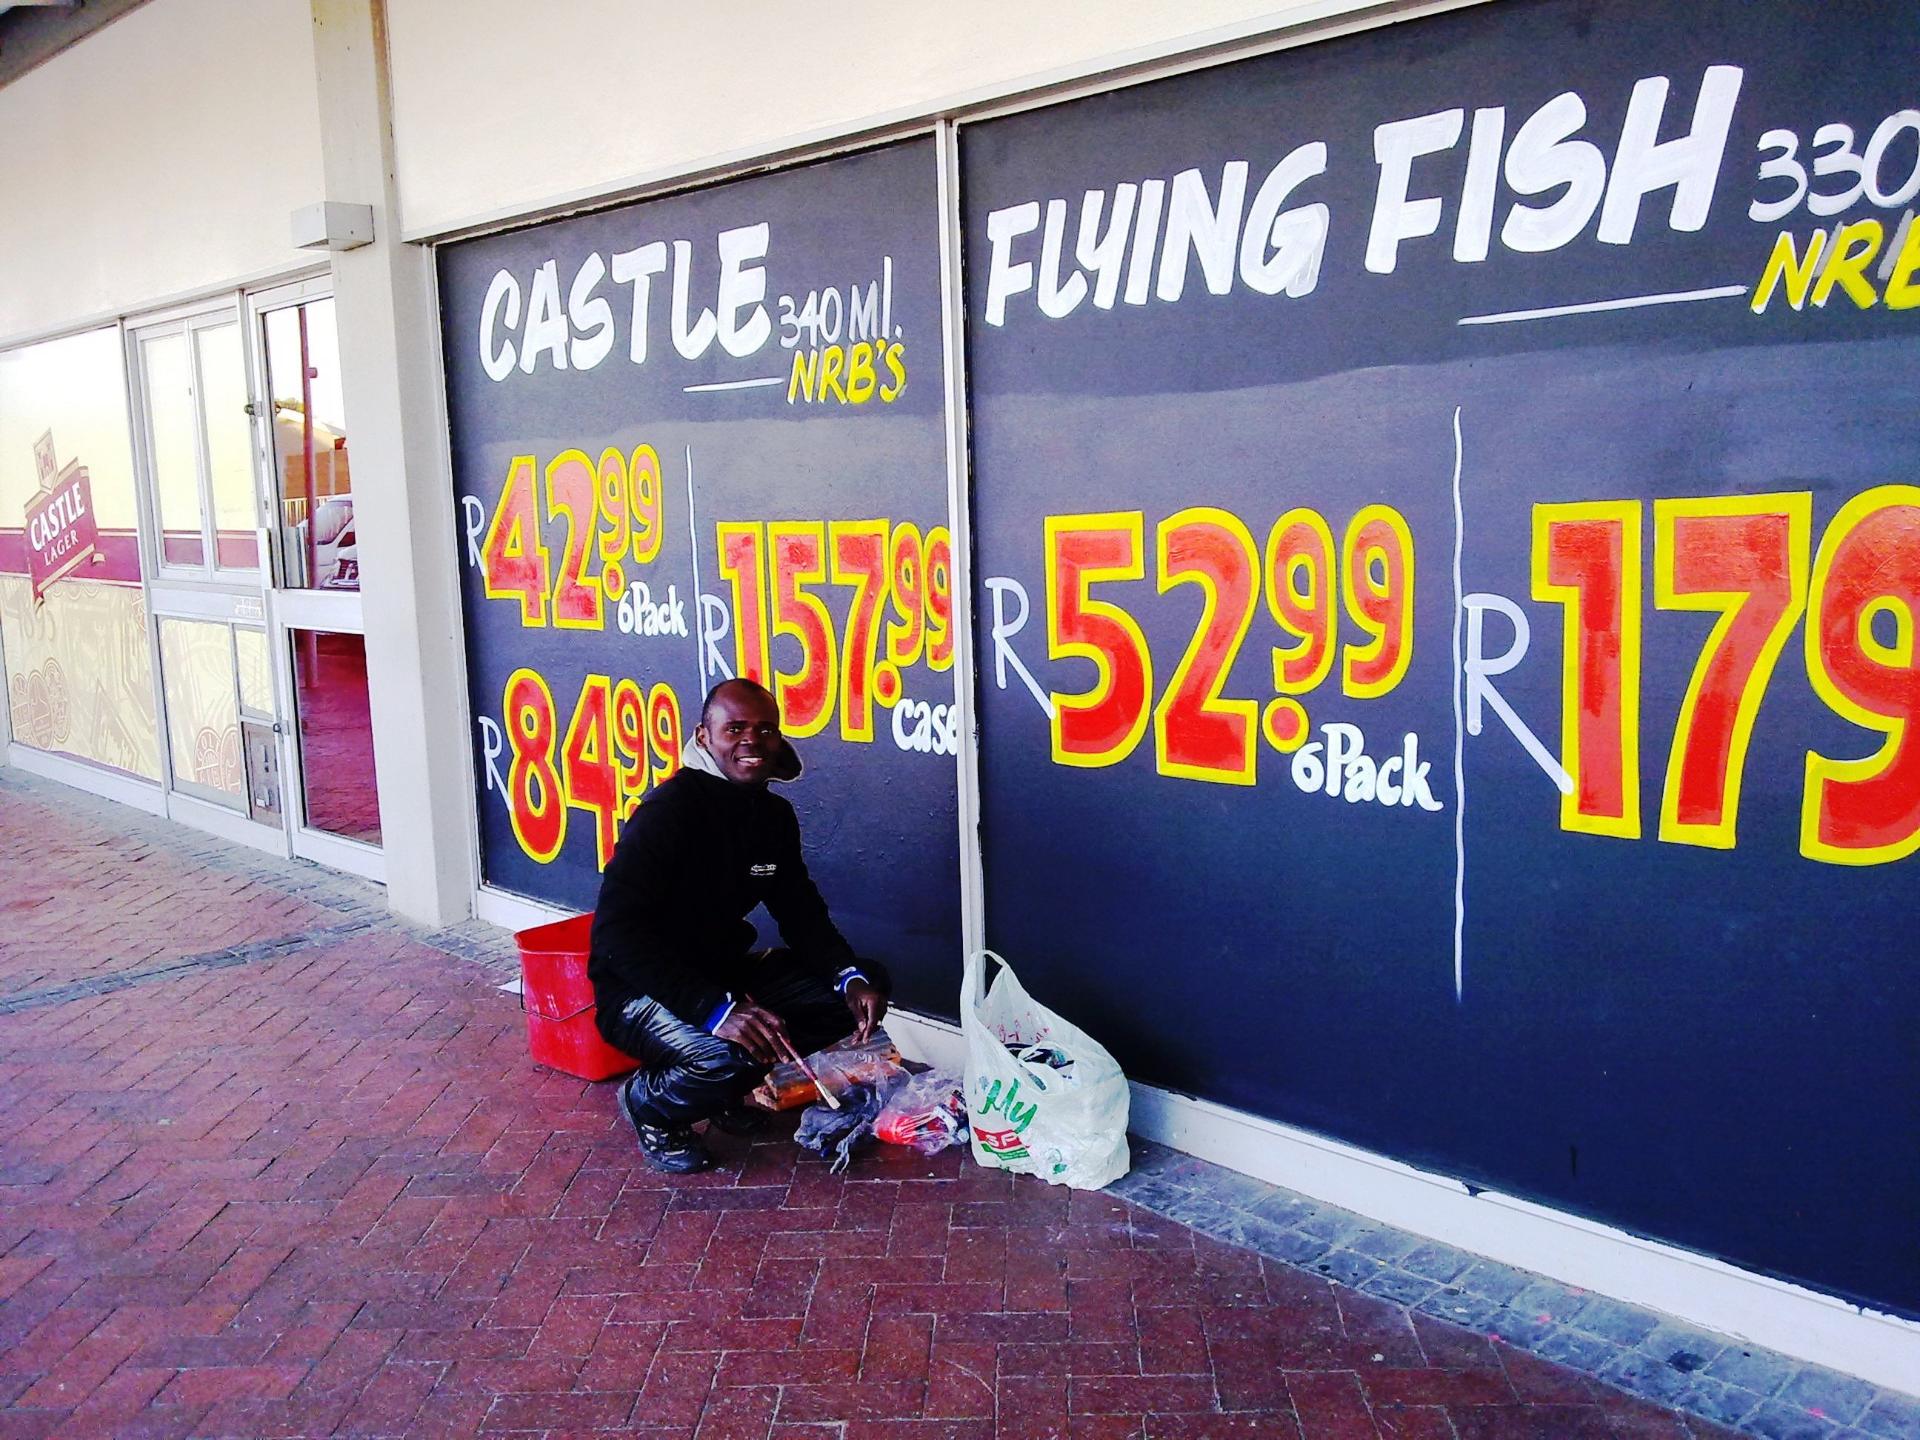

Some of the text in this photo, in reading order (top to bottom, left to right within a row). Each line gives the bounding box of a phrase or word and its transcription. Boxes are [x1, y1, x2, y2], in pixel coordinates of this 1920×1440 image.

[985, 141, 1330, 326] FLYING
[1364, 64, 1744, 274] FISH
[479, 222, 770, 382] CASTLE
[30, 481, 85, 552] CASTLE
[44, 529, 78, 566] LAGER
[617, 581, 689, 638] 6Pack
[1290, 722, 1443, 812] 6Pack
[977, 1078, 1038, 1134] My
